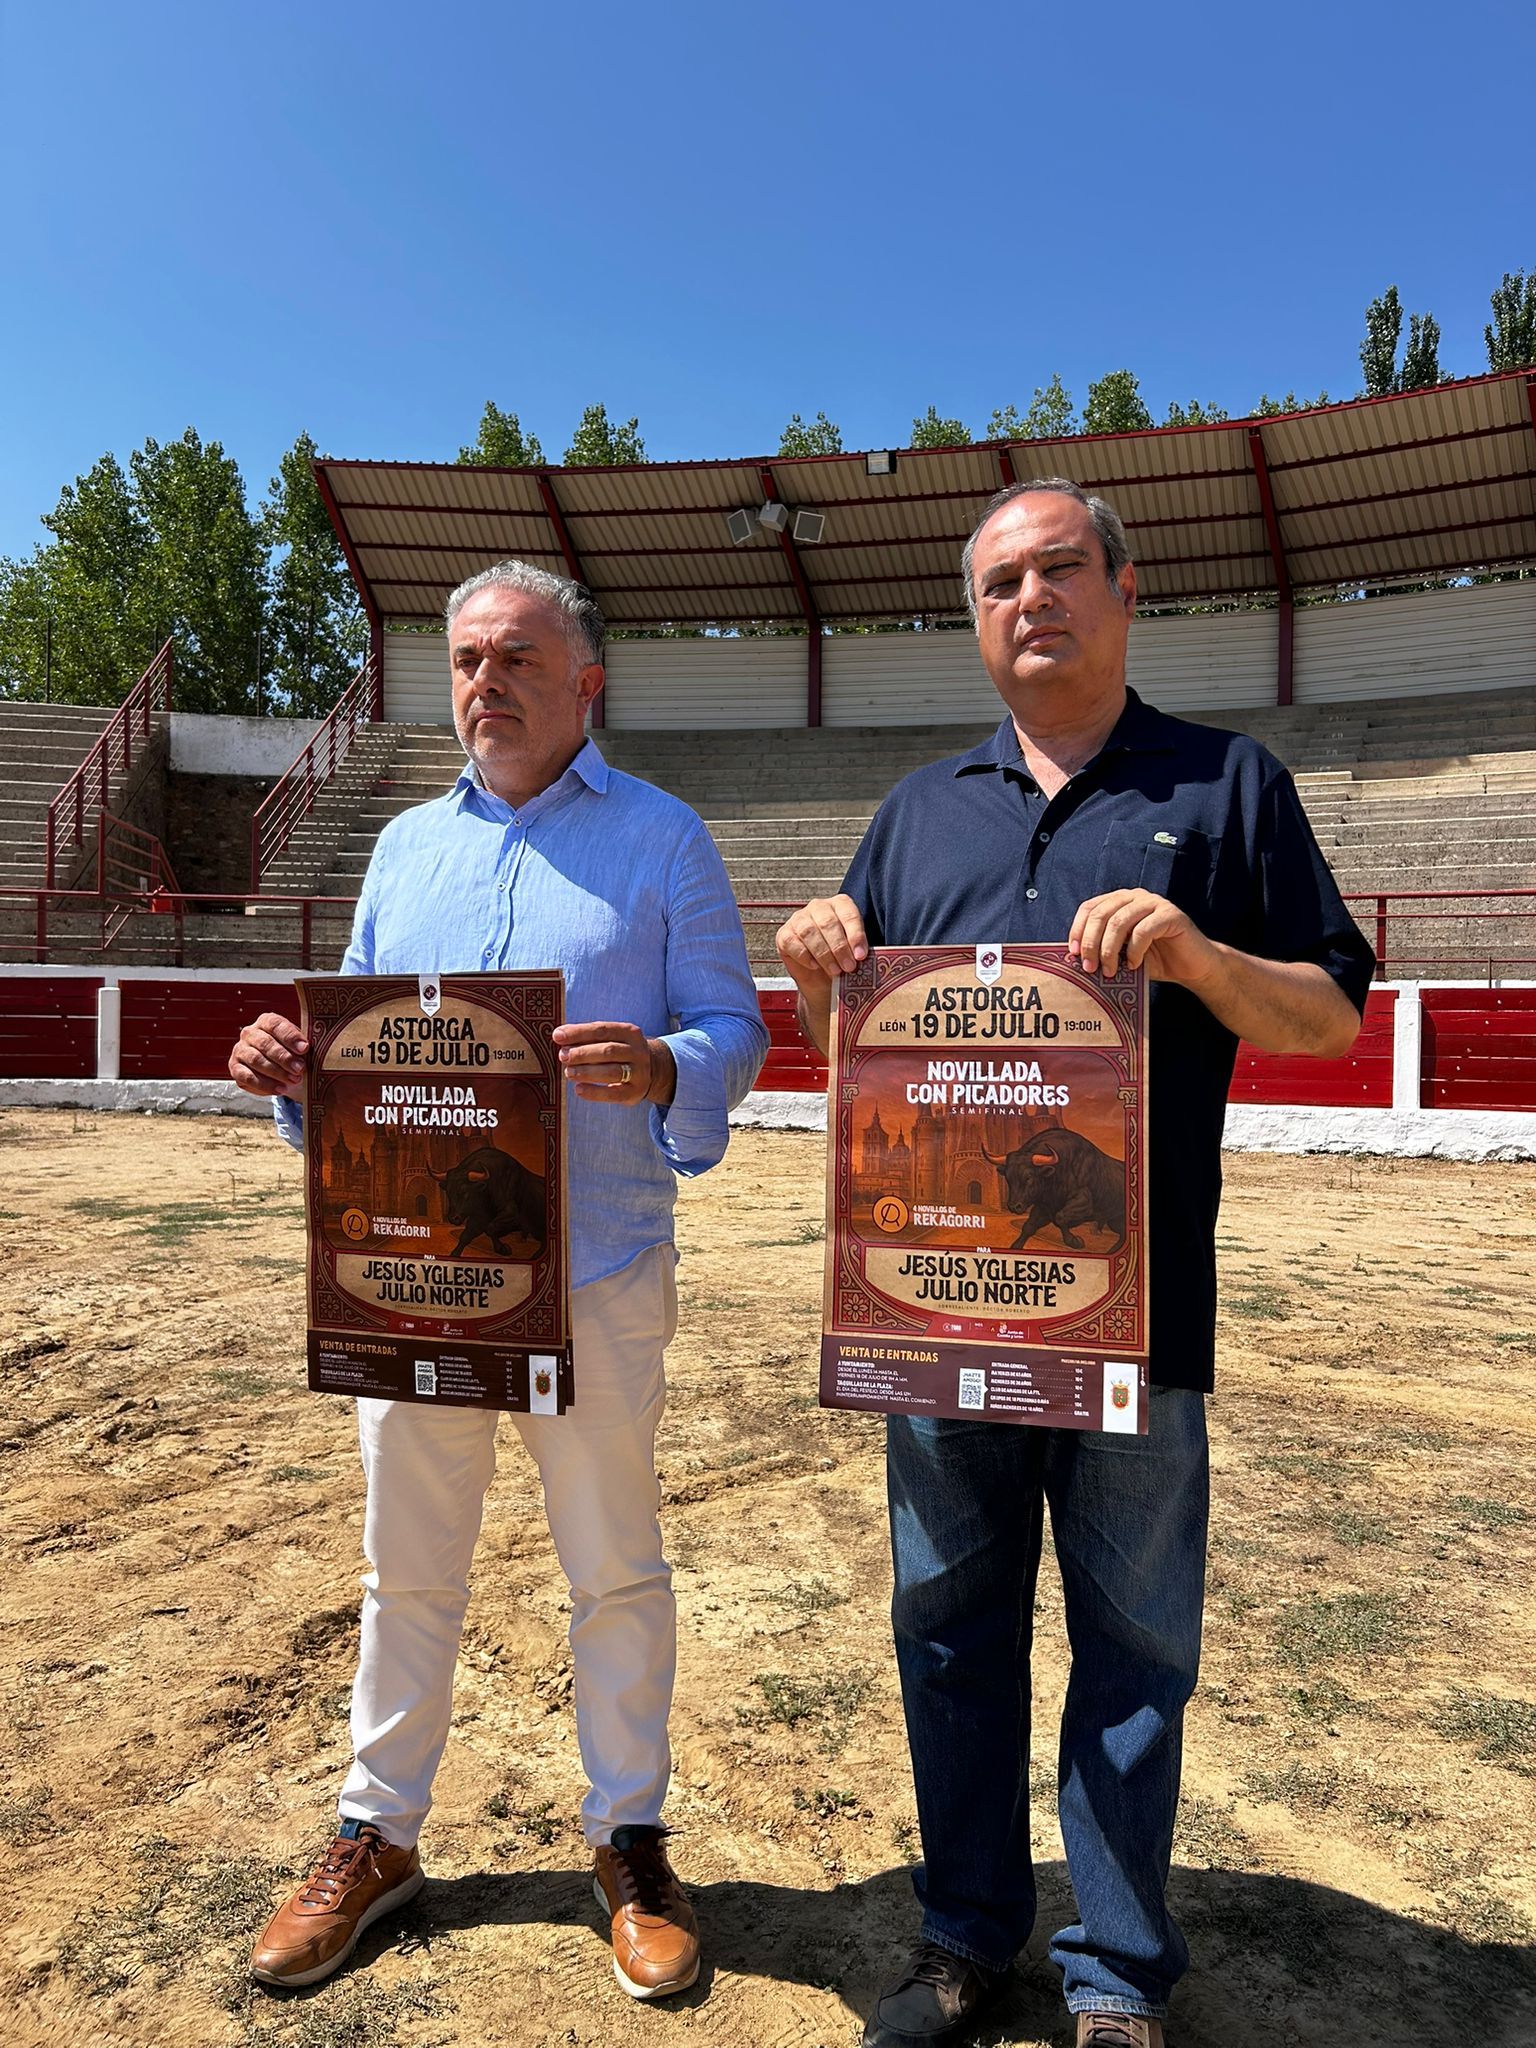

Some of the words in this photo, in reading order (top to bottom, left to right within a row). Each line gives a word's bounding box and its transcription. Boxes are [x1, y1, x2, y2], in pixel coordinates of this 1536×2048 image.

[924, 986, 1043, 1012] ASTORGA
[379, 1017, 475, 1041] ASTORGA
[879, 1019, 906, 1032] LEÓN
[911, 1013, 938, 1038] 19
[945, 1013, 977, 1038] DE
[981, 1012, 1060, 1039] JULIO
[1064, 1020, 1102, 1032] 19:00H
[341, 1046, 364, 1058] LEÓN
[367, 1041, 390, 1064] 19
[396, 1042, 422, 1065] DE
[425, 1042, 490, 1066] JULIO
[493, 1050, 525, 1060] 19:00H
[926, 1060, 1042, 1082] NOVILLADA
[382, 1085, 477, 1106] NOVILLADA
[906, 1084, 950, 1104] CON
[952, 1084, 1070, 1107] PICADORES
[364, 1106, 398, 1125] CON
[402, 1106, 498, 1128] PICADORES
[952, 1107, 1024, 1116] SEMIFINAL
[373, 1224, 430, 1238] REKAGORRI
[914, 1213, 985, 1229] REKAGORRI
[362, 1258, 417, 1282] JESÚS
[422, 1264, 504, 1288] YGLESIAS
[898, 1250, 967, 1278] JESÚS
[973, 1258, 1076, 1285] YGLESIAS
[376, 1282, 426, 1302] JULIO
[430, 1286, 489, 1308] NORTE
[916, 1279, 978, 1303] JULIO
[984, 1282, 1057, 1308] NORTE
[320, 1340, 344, 1350] VENTA
[346, 1343, 355, 1352] DE
[356, 1344, 397, 1356] ENTRADAS
[839, 1345, 870, 1358] VENTA
[873, 1348, 884, 1359] DE
[887, 1349, 939, 1363] ENTRADAS
